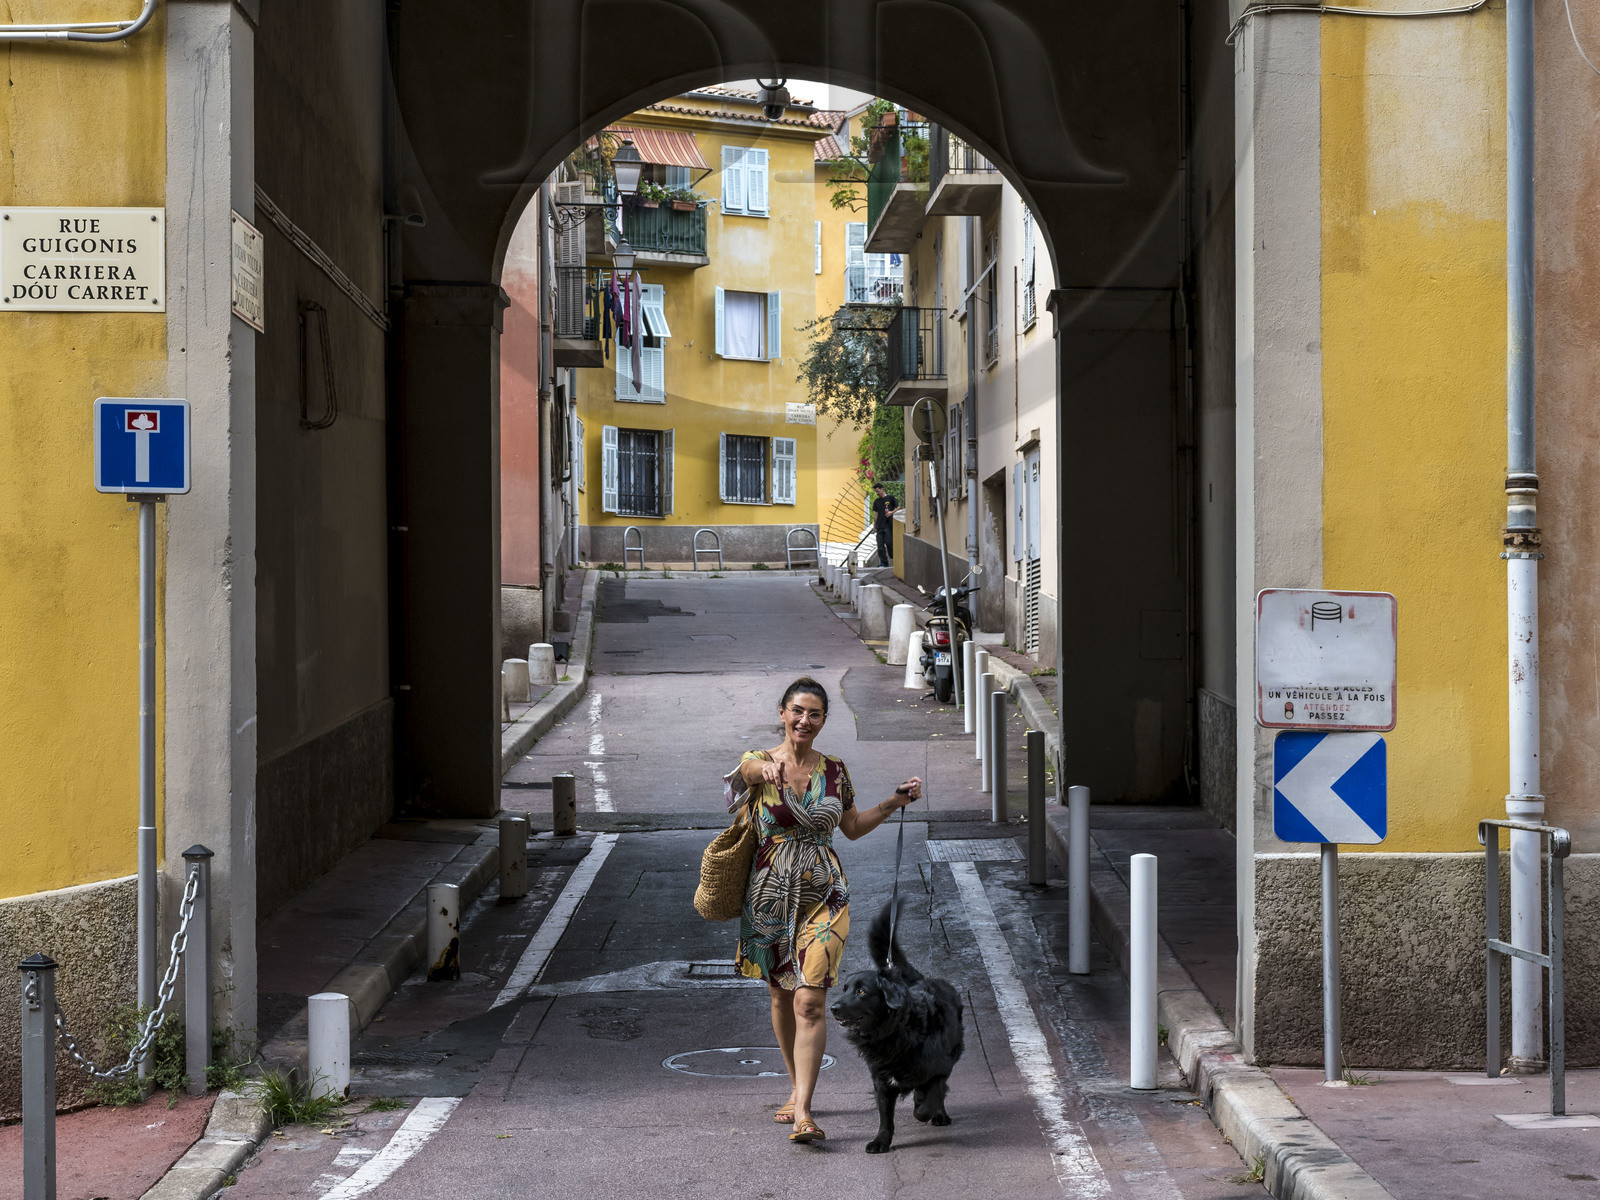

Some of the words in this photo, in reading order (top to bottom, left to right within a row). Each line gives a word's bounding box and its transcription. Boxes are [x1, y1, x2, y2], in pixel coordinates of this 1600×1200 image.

[59, 218, 100, 233] RUE
[22, 238, 137, 253] GUIGONIS
[23, 264, 137, 280] CARRIERA
[12, 281, 58, 299] DÓU
[67, 285, 149, 300] CARRET
[1268, 691, 1281, 699] UN
[1286, 690, 1333, 700] VÉHICULE
[1347, 693, 1359, 701] LA
[1363, 694, 1386, 702] FOIS
[1303, 703, 1351, 712] ATTENDEZ
[1309, 712, 1345, 720] PASSEZ
